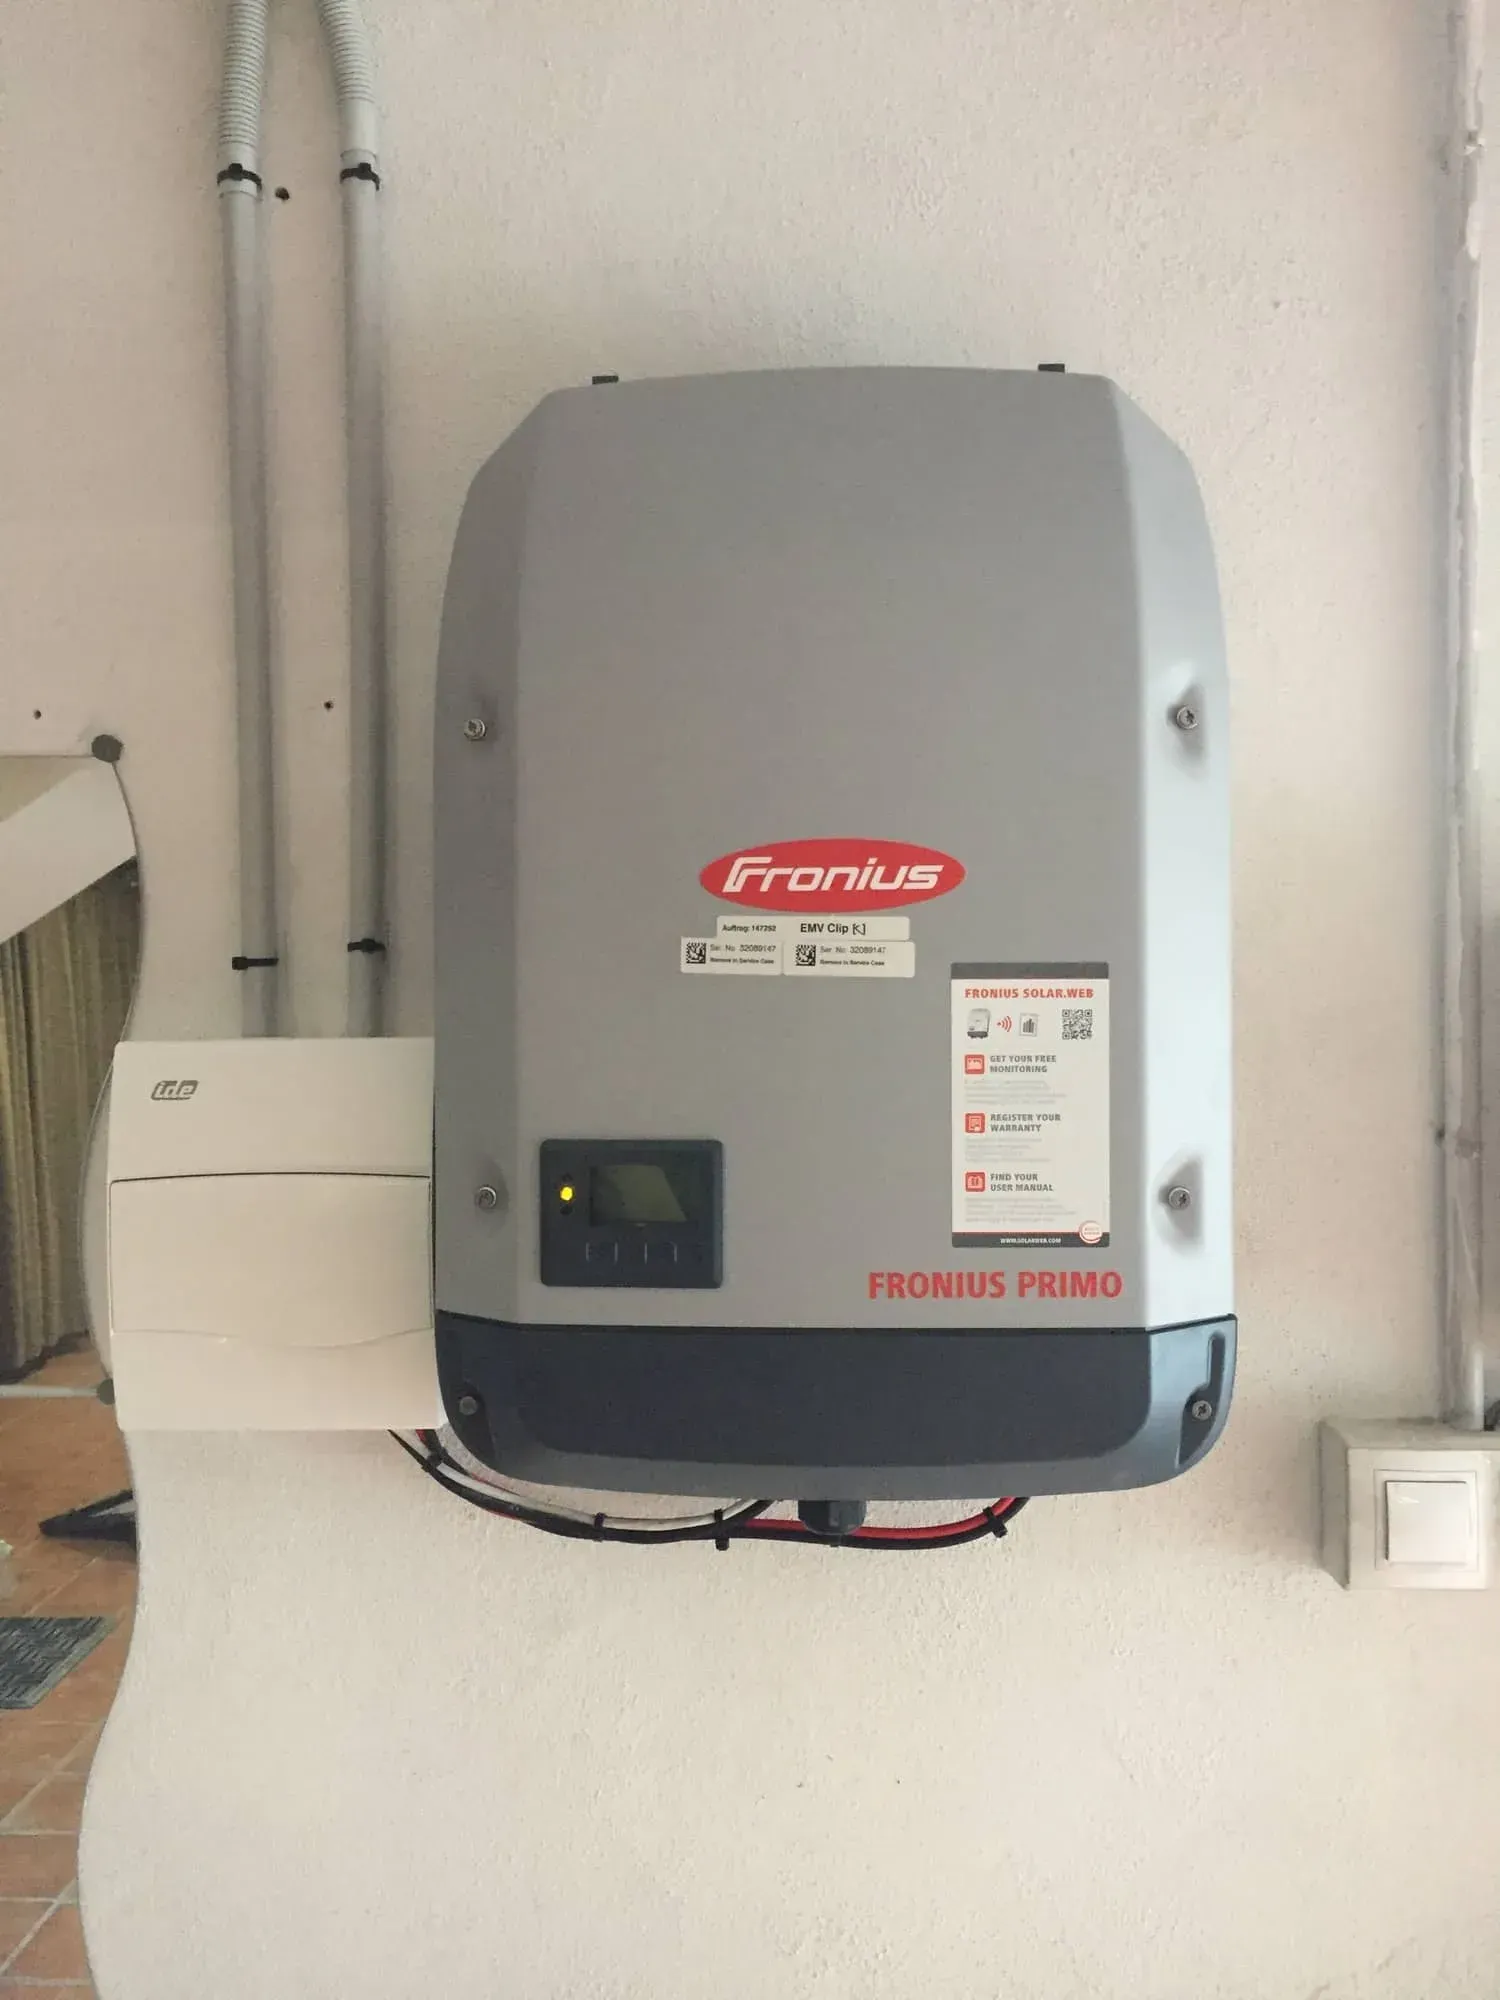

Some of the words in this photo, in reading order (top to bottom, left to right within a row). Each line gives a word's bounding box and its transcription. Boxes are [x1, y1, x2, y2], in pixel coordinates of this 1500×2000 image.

[722, 856, 944, 893] Fronius
[800, 923, 824, 933] EMV
[827, 923, 849, 935] Clip
[964, 988, 1019, 998] FRONIUS
[1023, 988, 1094, 998] SOLAR.WEB
[990, 1055, 1006, 1063] GET
[1009, 1055, 1033, 1063] YOUR
[1035, 1055, 1056, 1063] FREE
[990, 1065, 1048, 1073] MONITORING
[990, 1124, 1041, 1132] WARRANTY
[868, 1271, 1007, 1299] FRONIUS
[1018, 1271, 1122, 1298] PRIMO
